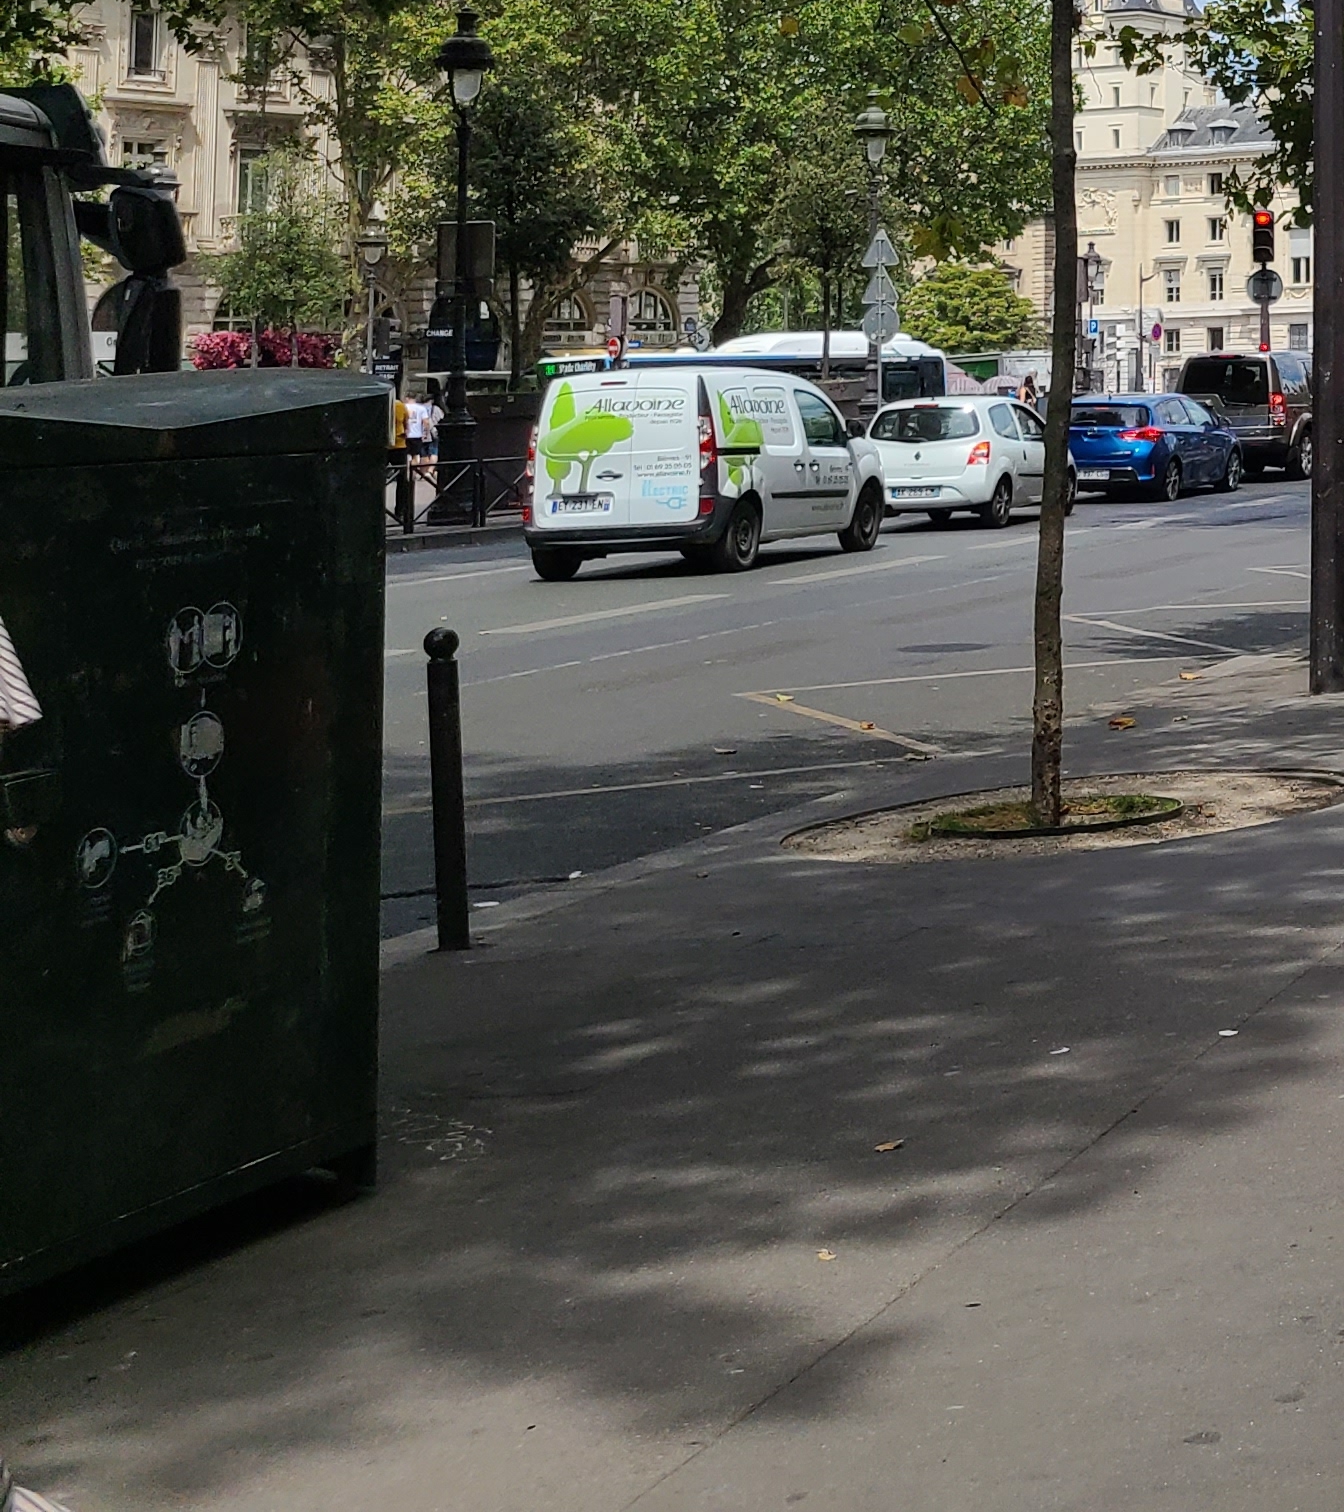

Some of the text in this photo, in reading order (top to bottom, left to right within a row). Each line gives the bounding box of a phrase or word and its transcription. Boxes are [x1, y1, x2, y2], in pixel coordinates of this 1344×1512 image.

[425, 329, 454, 337] CHANGE
[585, 398, 685, 414] Allavoine
[730, 394, 786, 414] Allavoine
